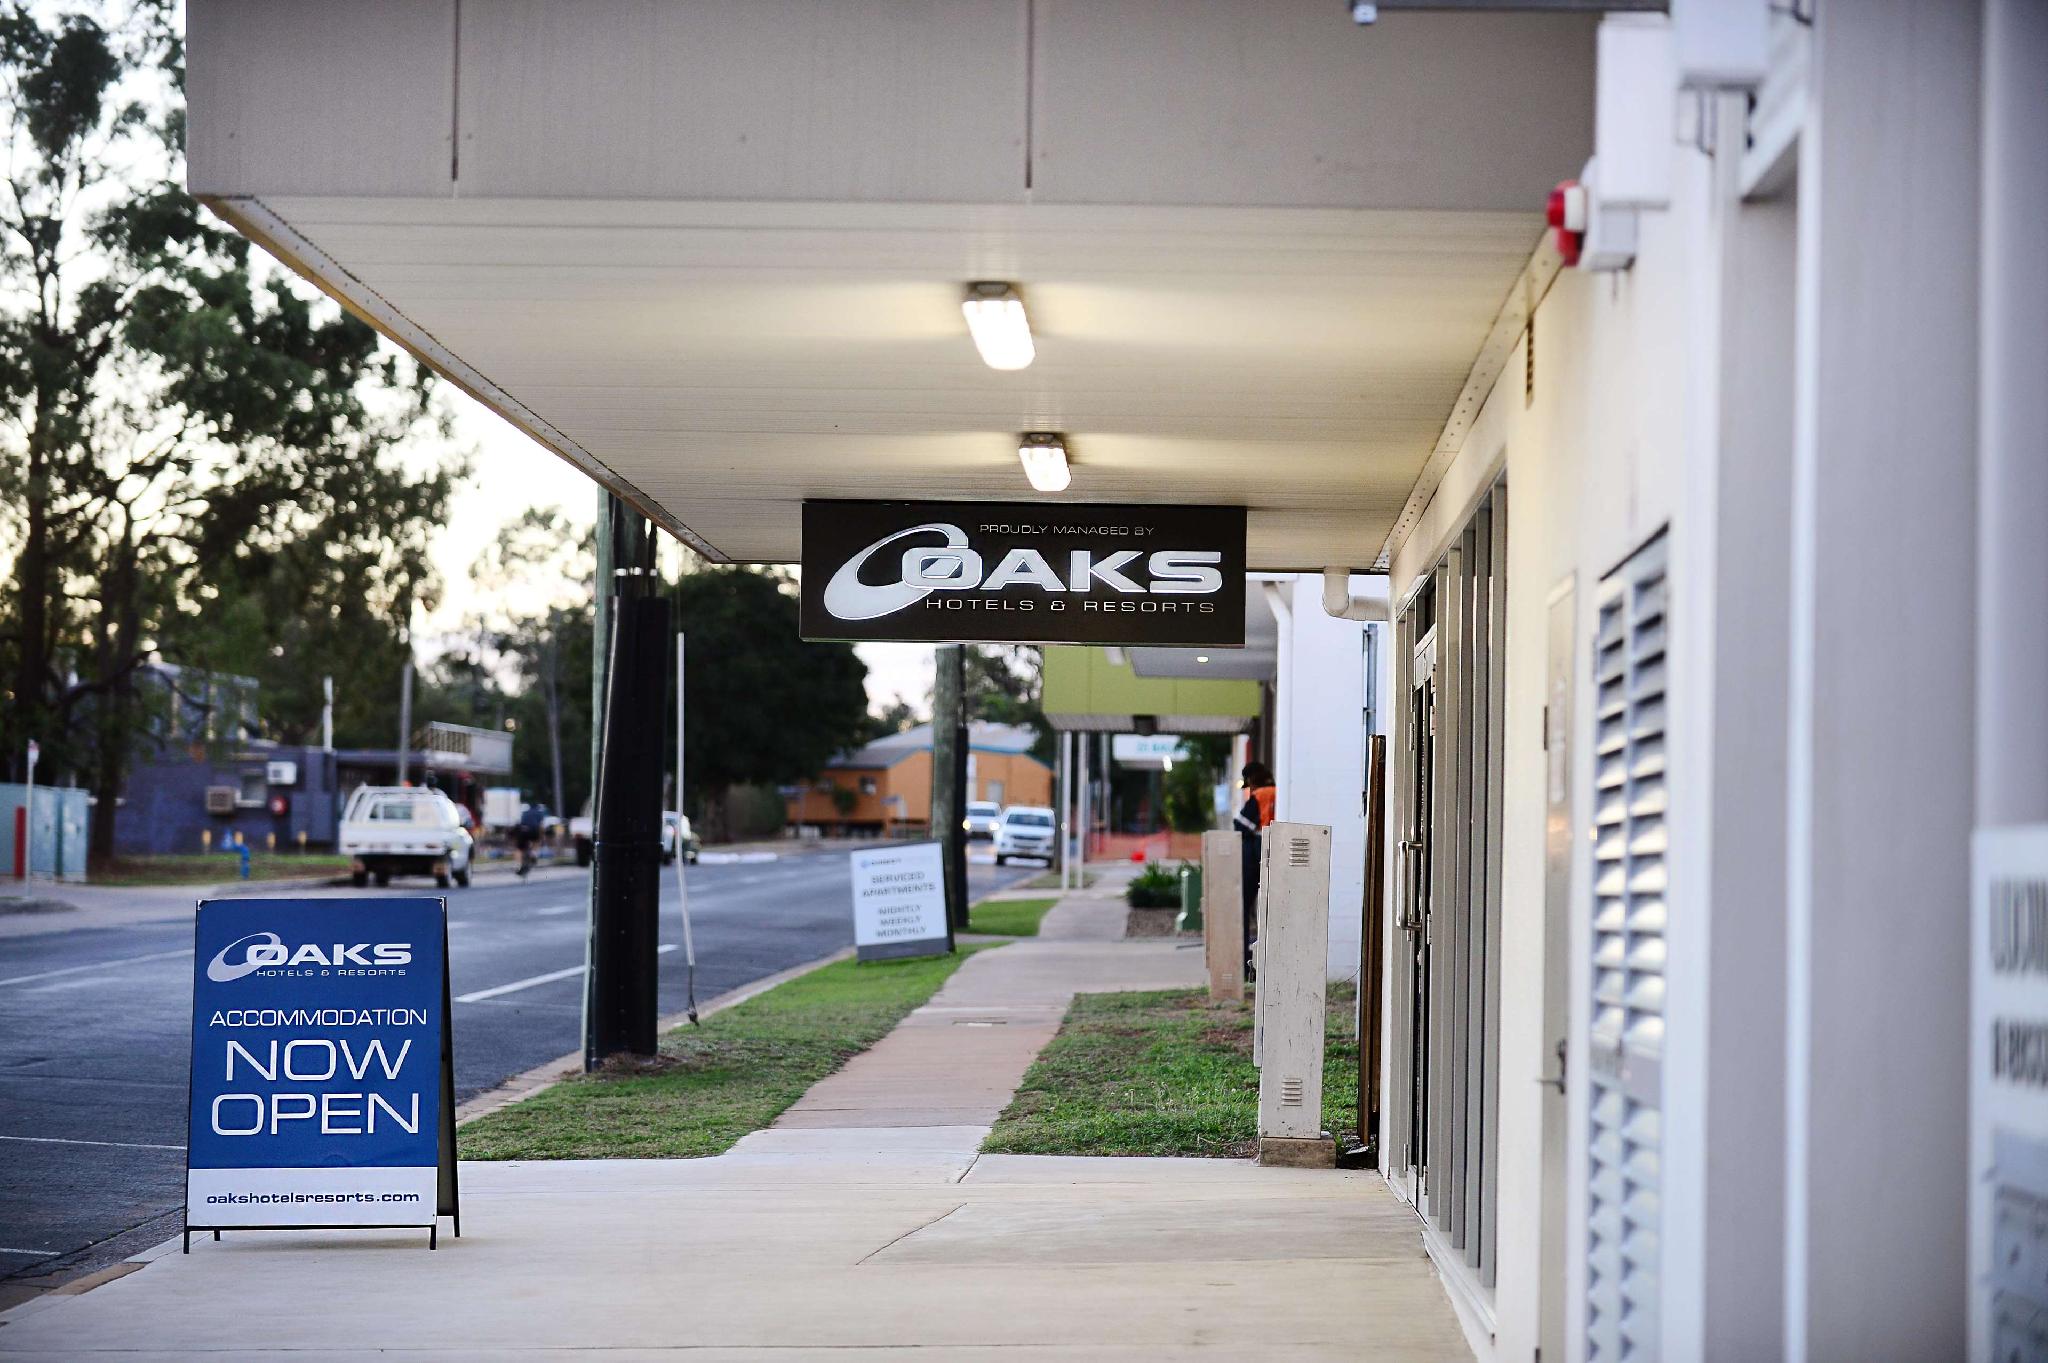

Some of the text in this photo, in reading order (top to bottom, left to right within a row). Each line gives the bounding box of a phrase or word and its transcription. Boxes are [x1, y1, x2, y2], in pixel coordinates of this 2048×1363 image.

[979, 524, 1155, 537] PROUDLY MANAGED BY
[902, 547, 1223, 594] OAKS
[926, 598, 1215, 614] HOTELS & RESORTS
[246, 943, 412, 966] OAKS
[256, 968, 407, 977] HOTELS & RESORTS
[210, 1009, 427, 1027] ACCOMMODATION
[226, 1039, 412, 1081] NOW
[211, 1093, 420, 1136] OPEN
[206, 1191, 420, 1205] oakshotelsresorts.com
